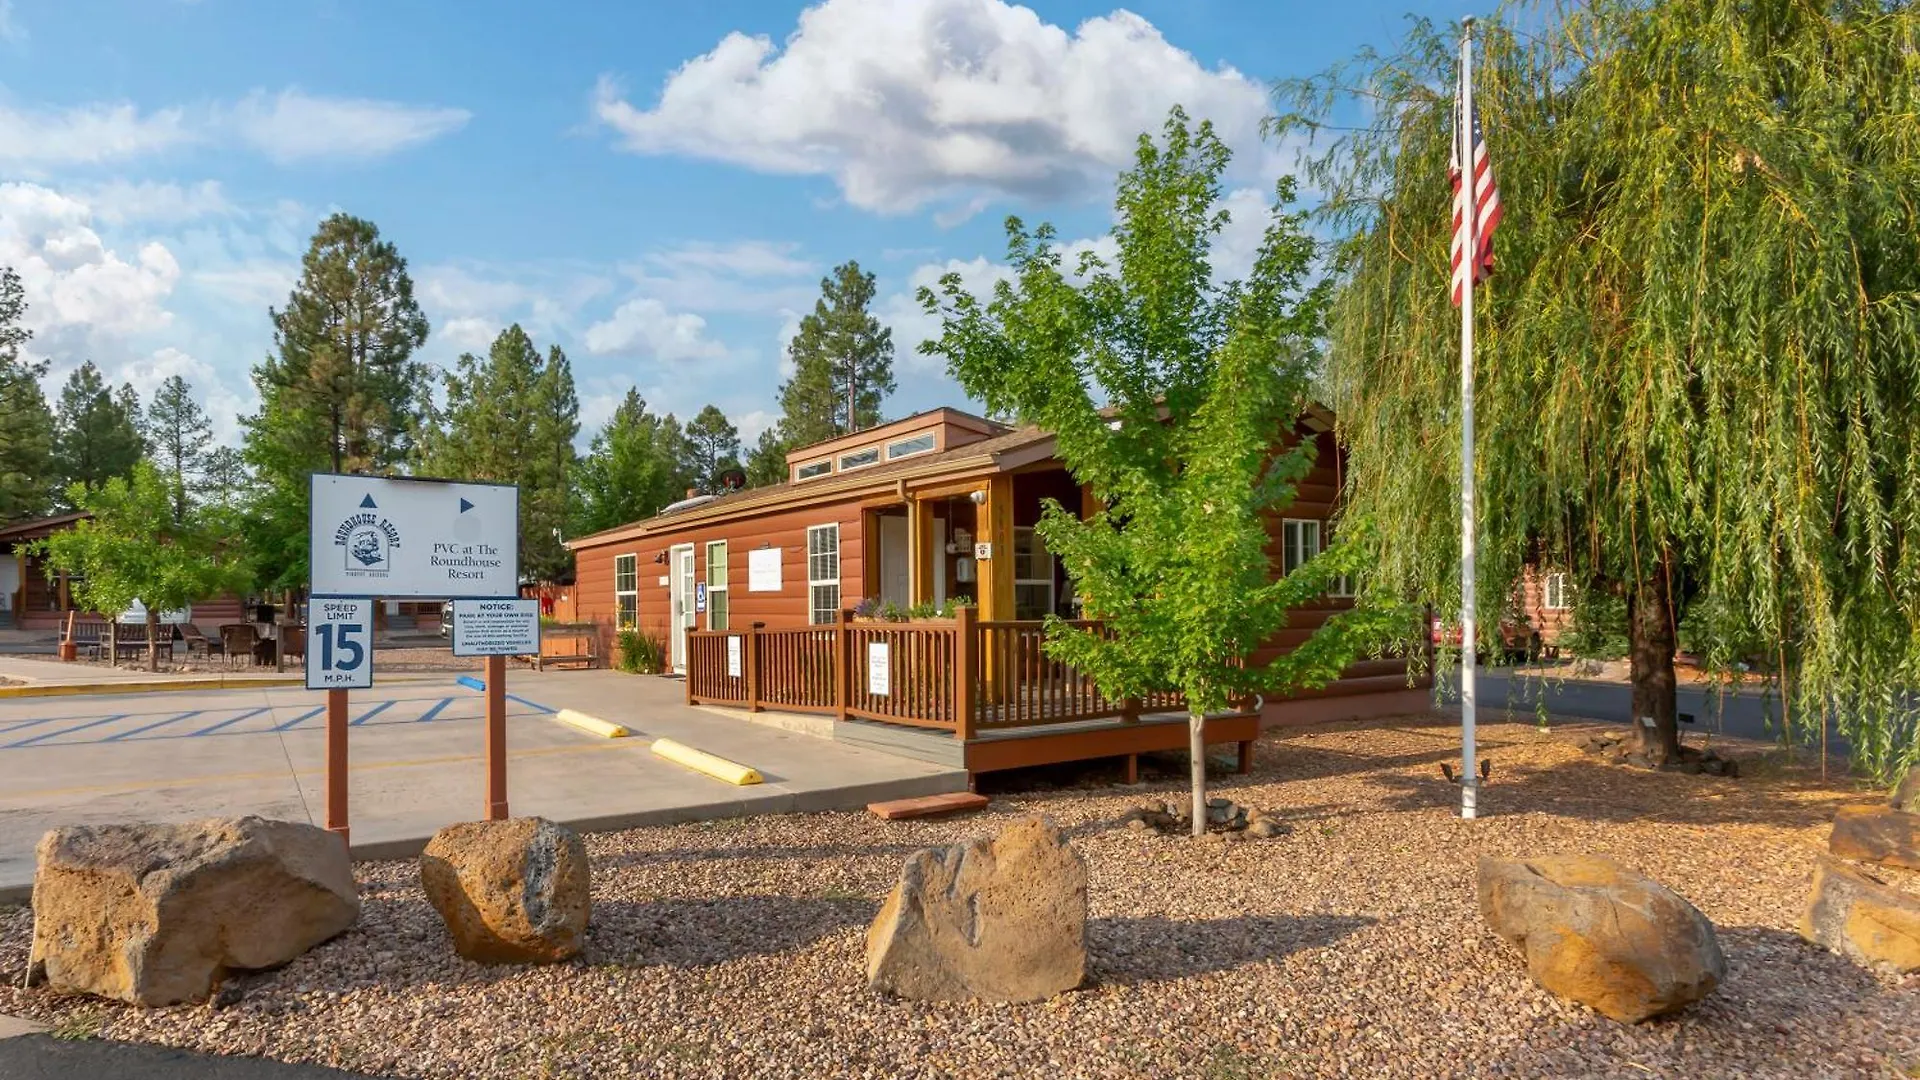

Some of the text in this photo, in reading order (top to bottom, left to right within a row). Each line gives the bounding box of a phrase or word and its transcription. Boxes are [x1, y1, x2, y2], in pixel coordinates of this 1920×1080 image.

[379, 518, 400, 548] RESORT
[433, 543, 498, 555] PVC at The
[430, 556, 501, 568] Roundhouse
[448, 568, 484, 579] Resort
[323, 603, 358, 612] SPEED
[327, 612, 354, 620] LIMIT
[315, 623, 364, 671] 15
[324, 675, 355, 683] M.P.H.
